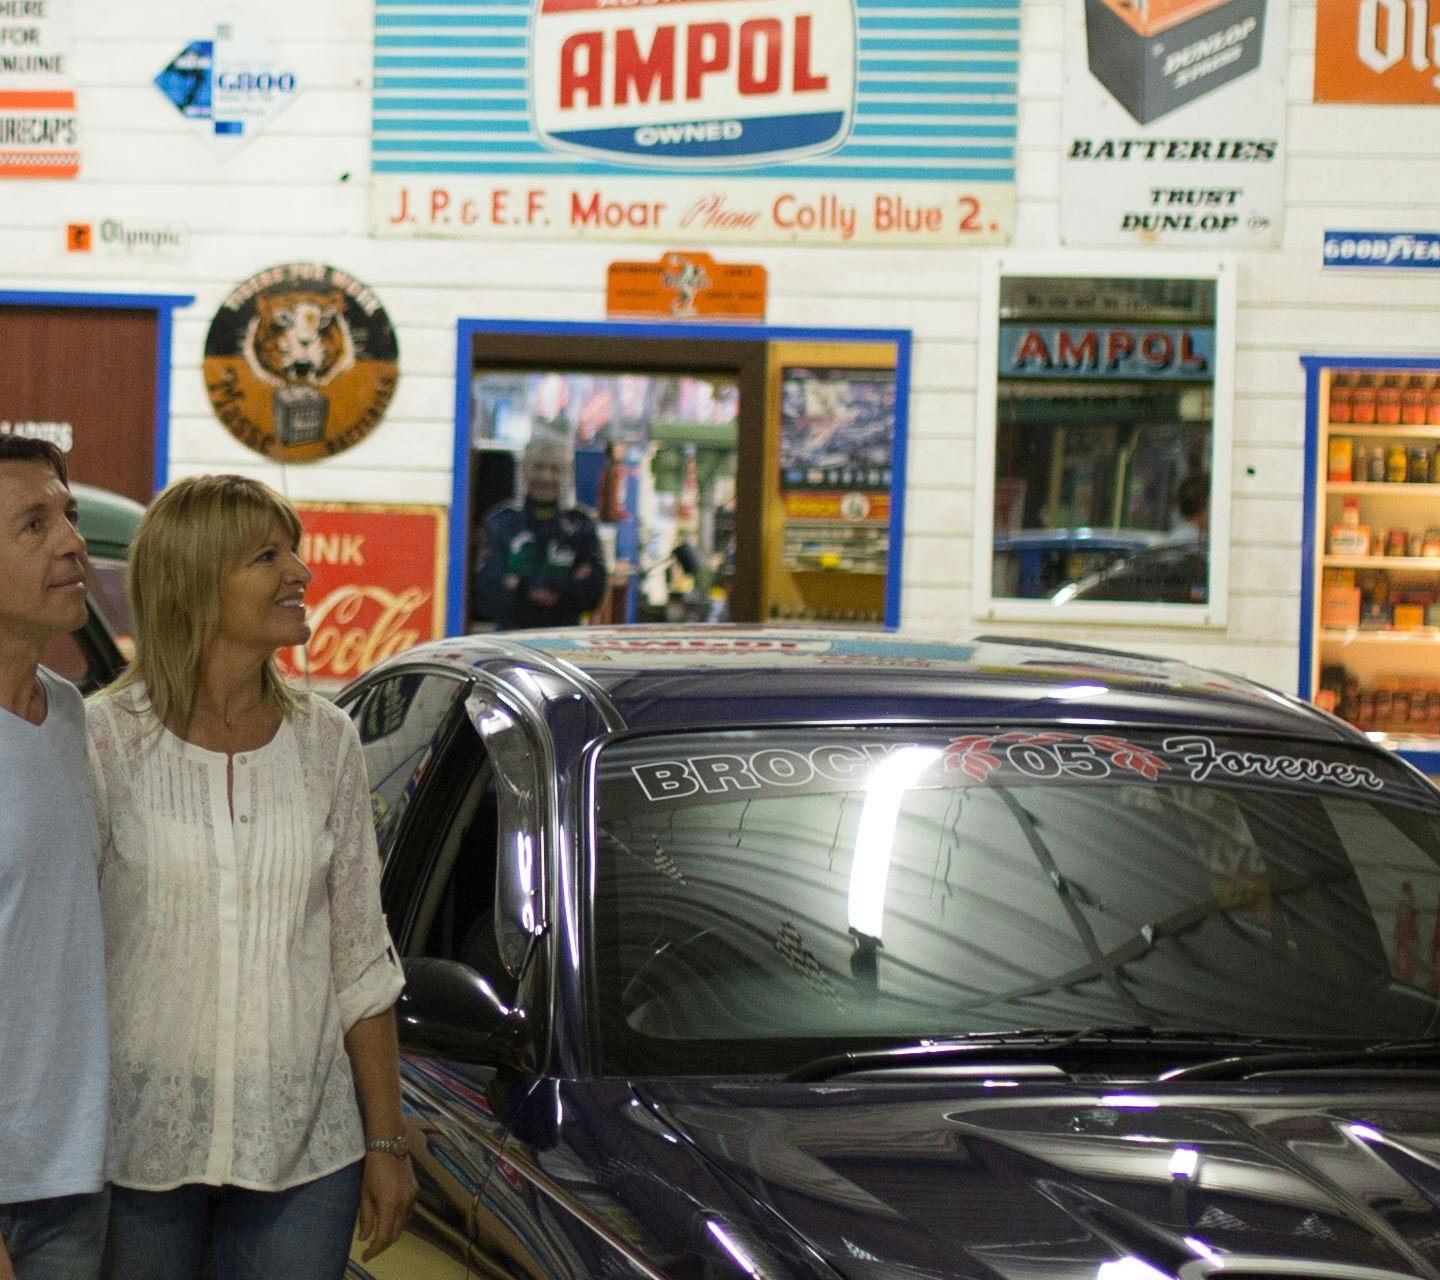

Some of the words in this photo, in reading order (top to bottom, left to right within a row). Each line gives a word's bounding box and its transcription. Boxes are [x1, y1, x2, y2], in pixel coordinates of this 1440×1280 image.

[0, 26, 40, 45] FOR
[1162, 18, 1257, 80] DUNLOP
[558, 15, 829, 113] AMPOL
[633, 120, 744, 148] OWNED
[1066, 139, 1278, 164] BATTERIES
[1148, 188, 1243, 207] TRUST
[570, 193, 666, 227] Moar
[772, 195, 858, 241] Colly
[874, 195, 944, 232] Blue
[1120, 212, 1240, 234] DUNLOP
[99, 218, 182, 247] Olympic
[1018, 328, 1207, 371] AMPOL
[1006, 741, 1113, 780] 05
[1162, 735, 1384, 790] Forever
